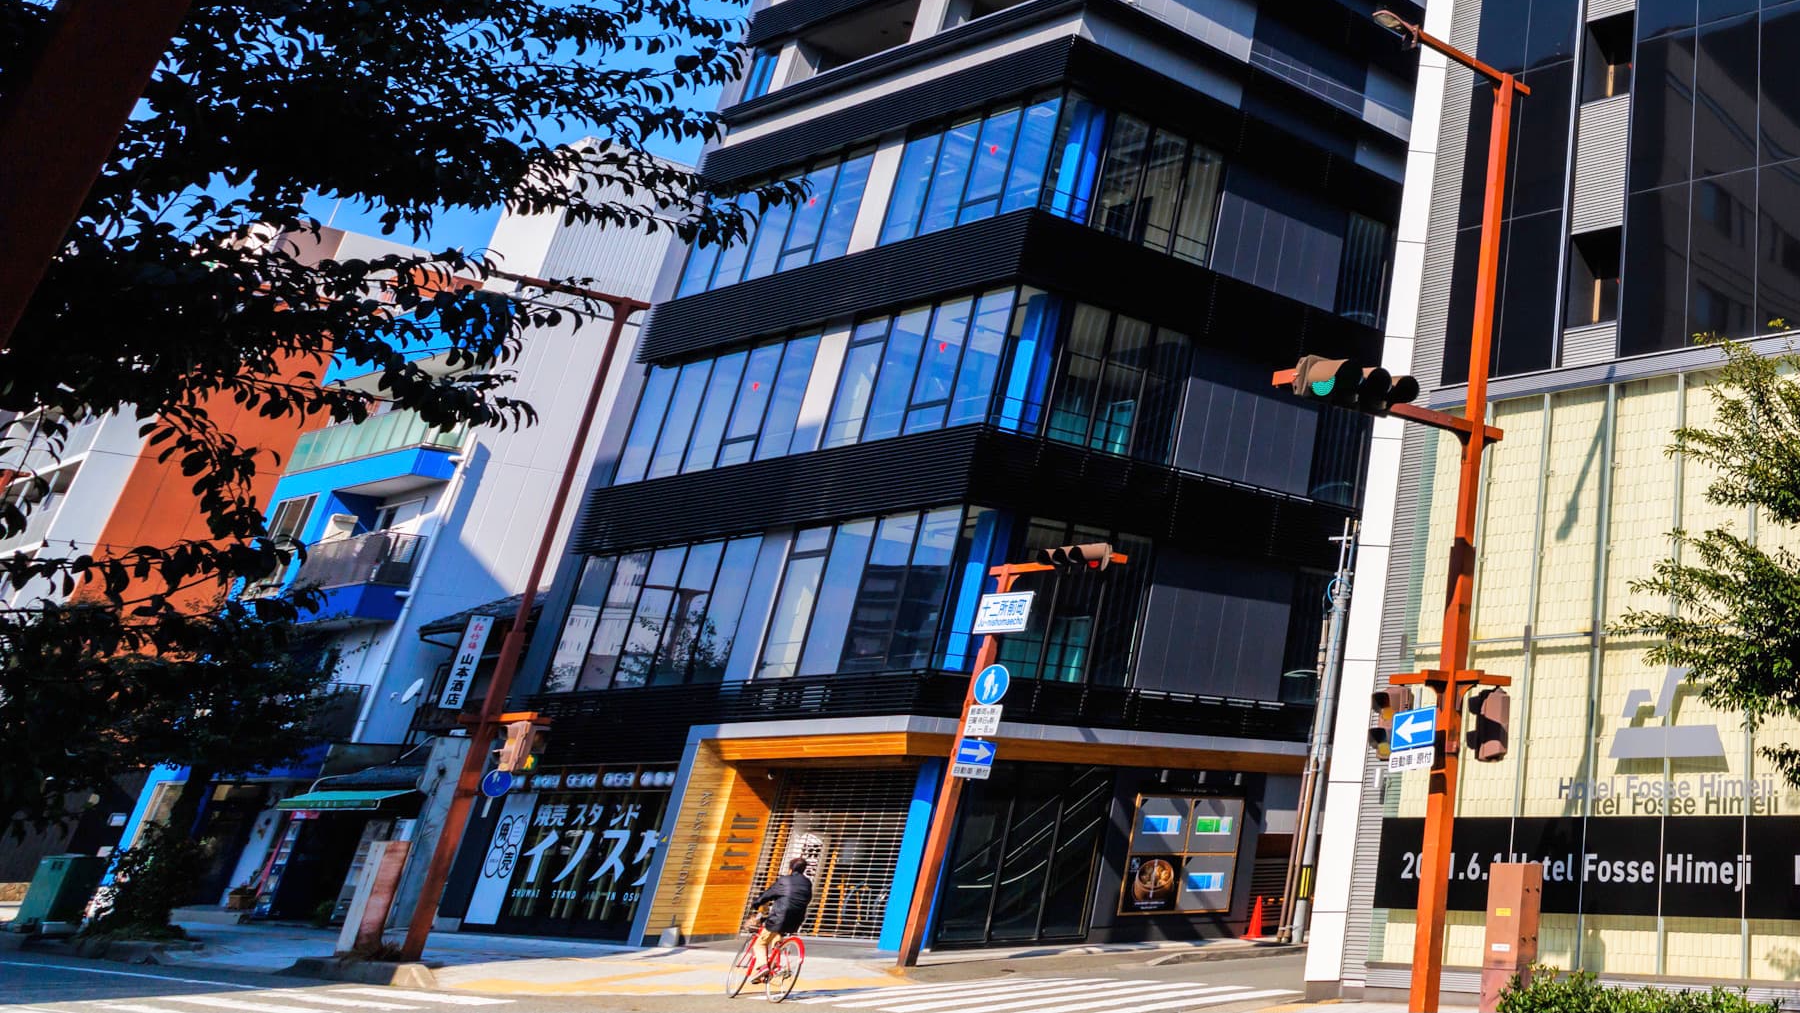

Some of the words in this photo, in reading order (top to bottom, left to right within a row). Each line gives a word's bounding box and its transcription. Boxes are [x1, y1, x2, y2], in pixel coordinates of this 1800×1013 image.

[982, 599, 1027, 617] 十二所前町
[445, 653, 475, 706] 山本酒店
[1558, 776, 1614, 799] Hotel
[1626, 775, 1690, 799] Fosse
[1699, 774, 1774, 804] Himeji
[1401, 851, 1502, 881] 21.6.
[1583, 853, 1655, 883] Fosse
[1665, 853, 1752, 892] Himeji
[552, 890, 577, 900] STAND
